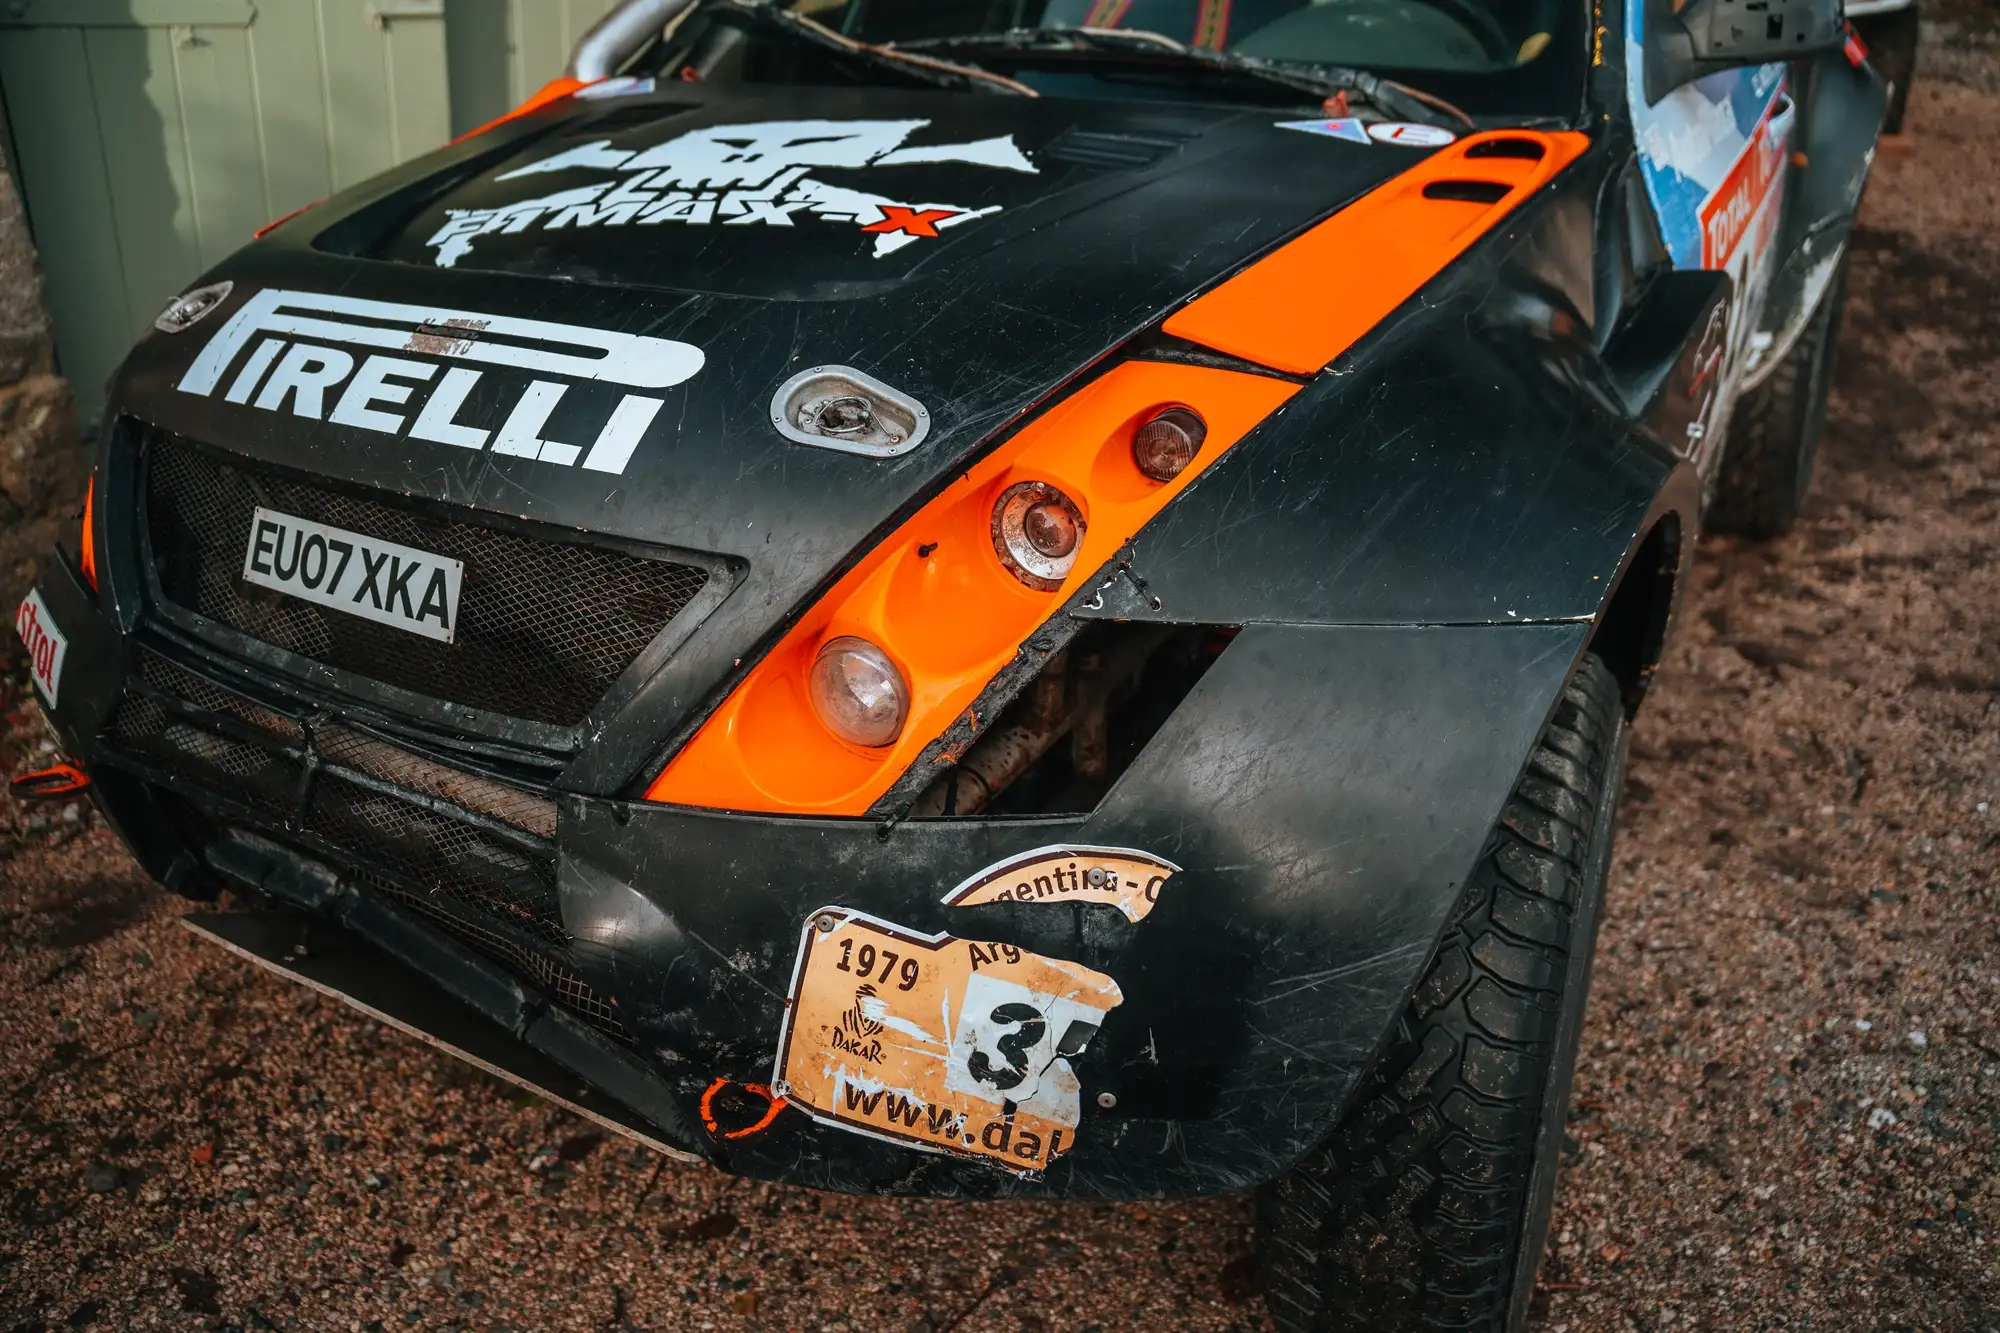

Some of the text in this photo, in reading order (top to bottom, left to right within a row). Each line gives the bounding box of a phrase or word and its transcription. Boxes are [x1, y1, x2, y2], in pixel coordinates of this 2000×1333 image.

[1709, 177, 1751, 268] TOTAL
[177, 288, 705, 475] PIRELLI
[251, 519, 450, 630] EU07 XKA
[16, 602, 57, 694] strol
[836, 938, 919, 991] 1979
[968, 942, 1031, 972] Arg
[831, 1026, 882, 1065] DAKAR
